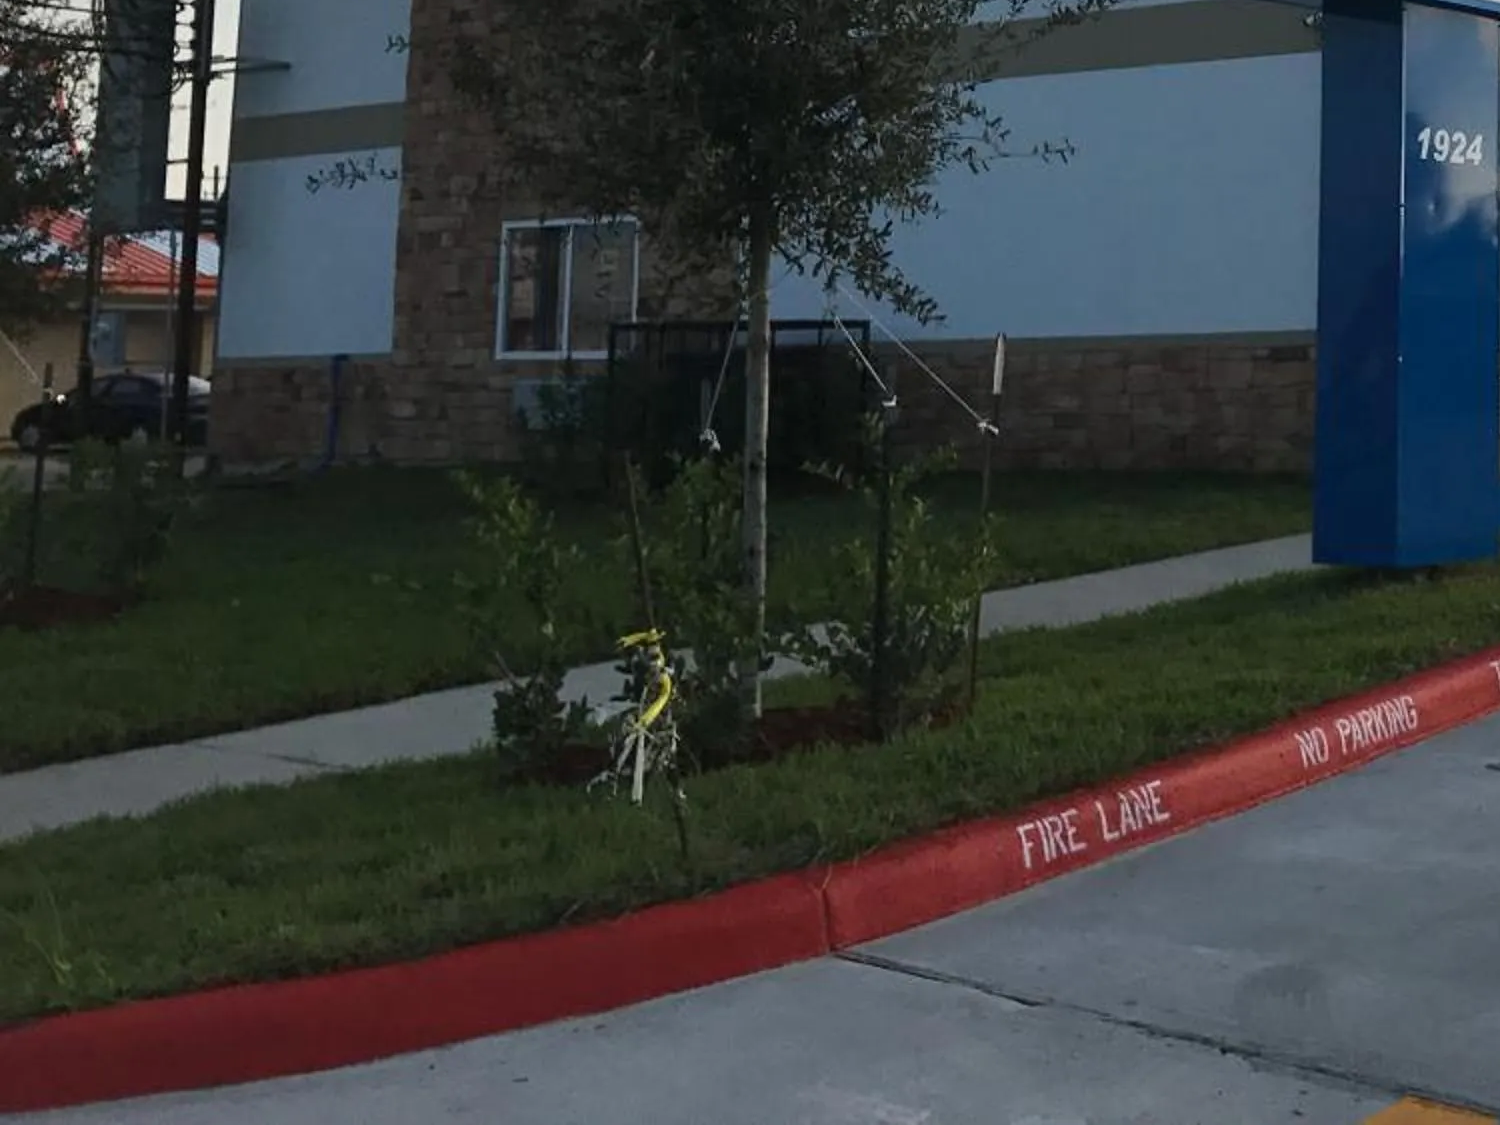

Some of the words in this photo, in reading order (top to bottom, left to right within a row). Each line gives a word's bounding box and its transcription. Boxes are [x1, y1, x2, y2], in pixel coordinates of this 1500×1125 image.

[1416, 126, 1484, 166] 1924
[1294, 726, 1330, 770] NO
[1335, 695, 1418, 755] PARKING
[1016, 808, 1088, 870] FIRE
[1094, 779, 1171, 843] LANE
